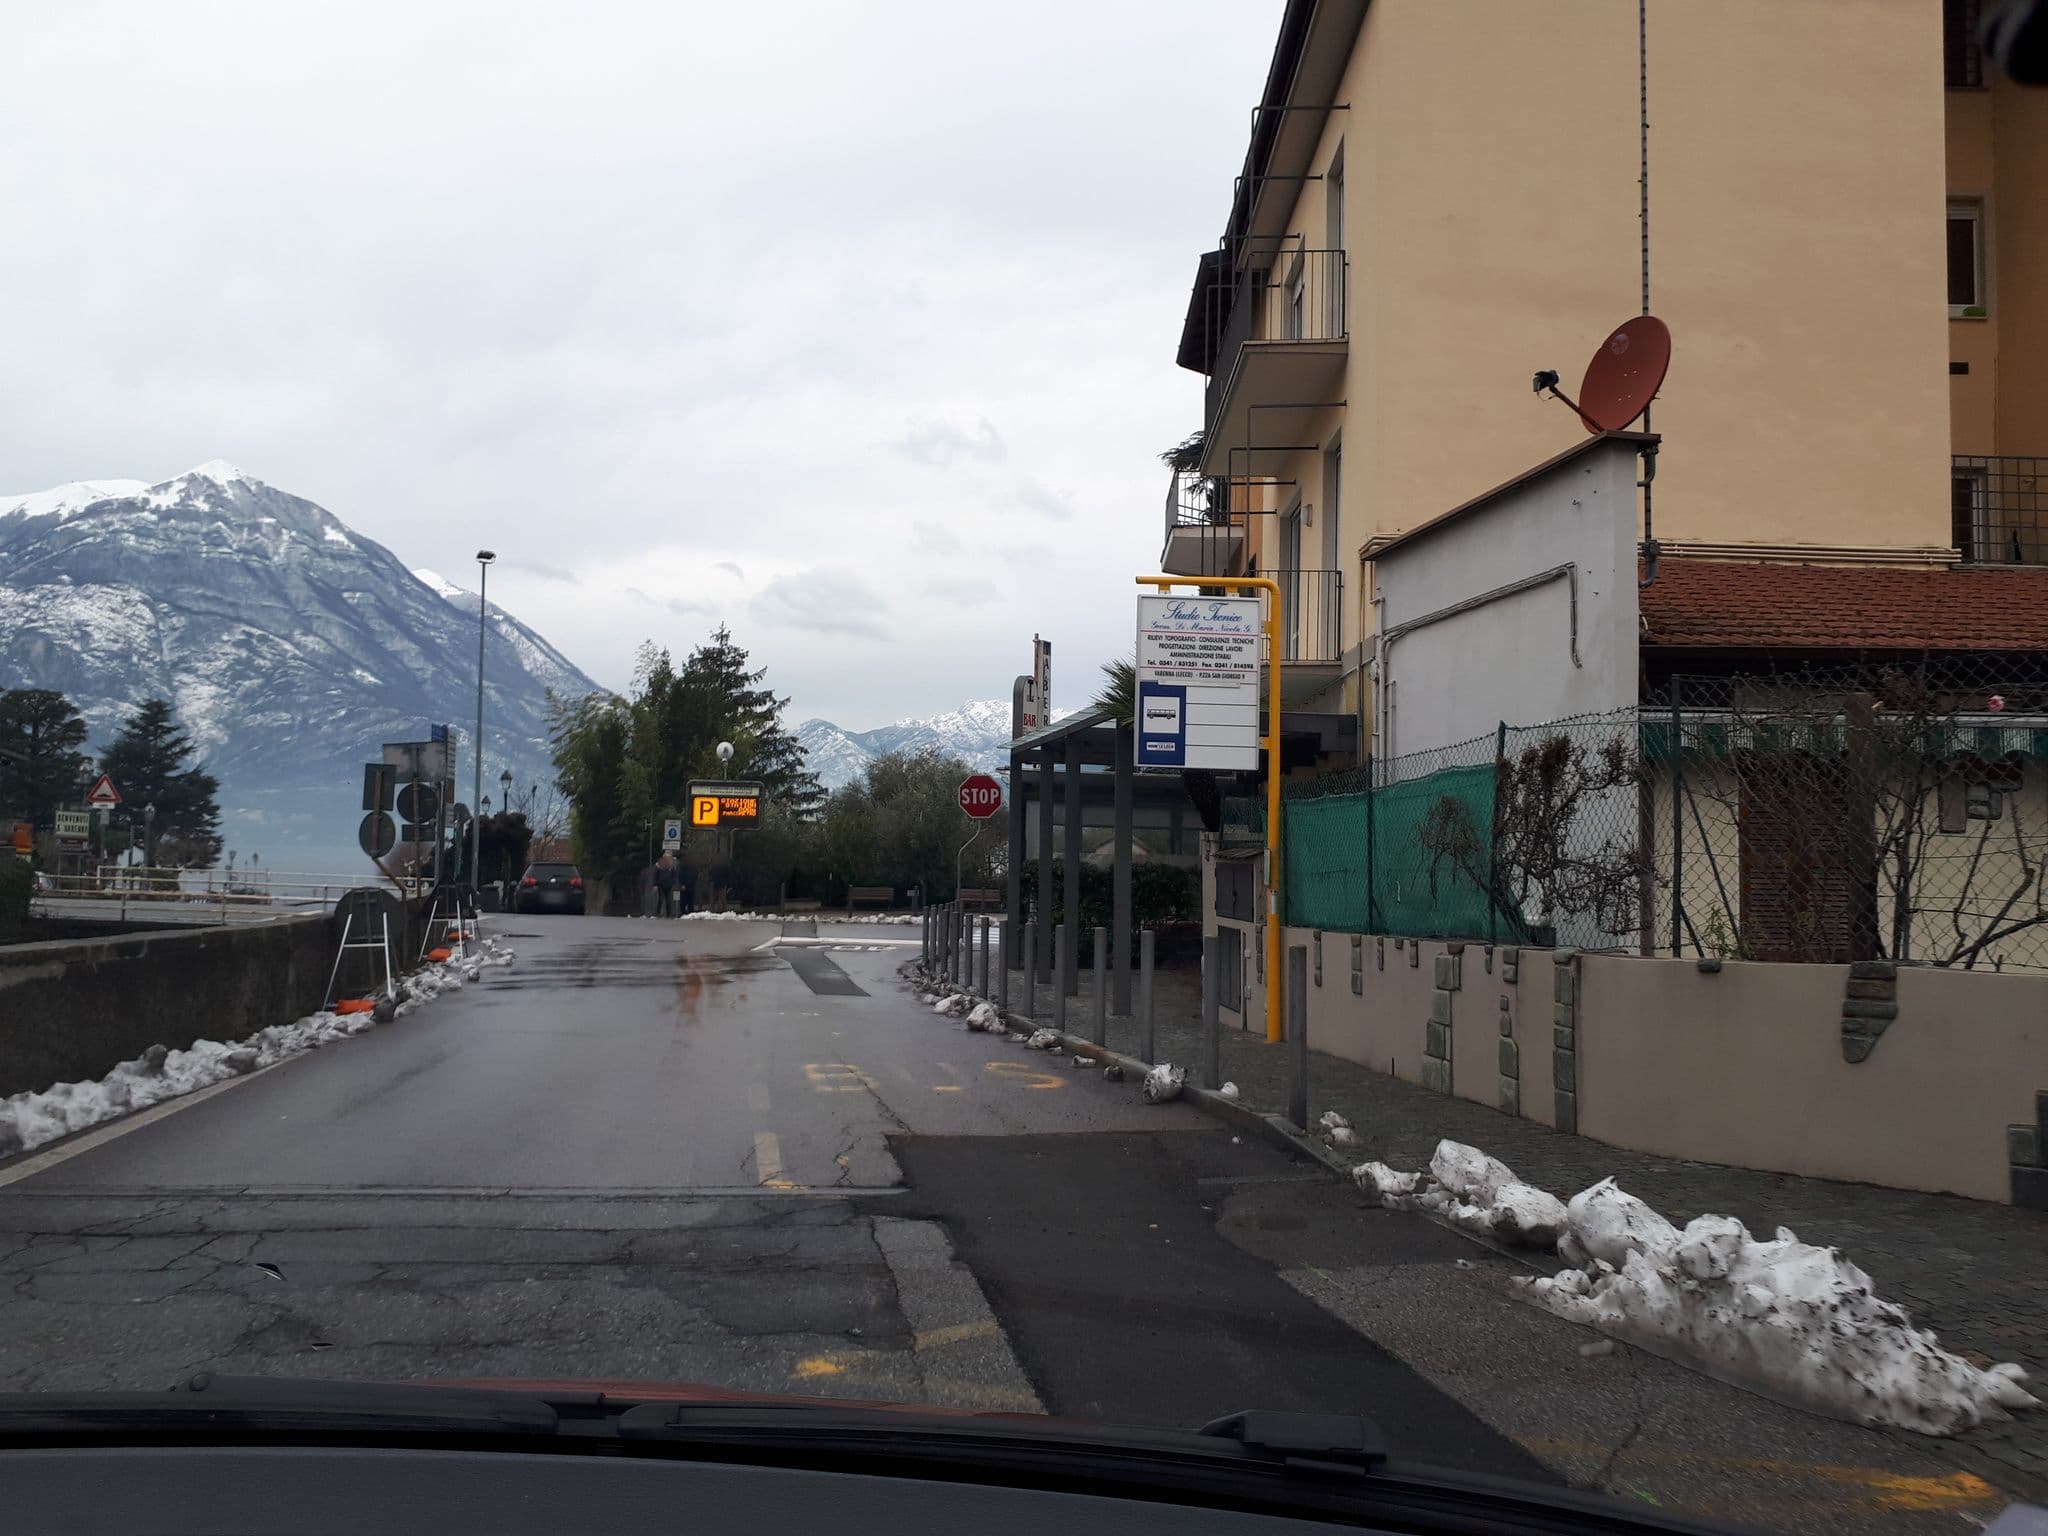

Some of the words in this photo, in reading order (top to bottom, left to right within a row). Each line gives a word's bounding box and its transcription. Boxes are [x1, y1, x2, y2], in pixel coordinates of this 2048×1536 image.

[1162, 601, 1200, 620] Studio
[1203, 602, 1243, 622] Tecnico
[1170, 651, 1214, 659] AMMINISTRAZIONE
[1023, 713, 1037, 728] BAR
[961, 788, 999, 804] STOP
